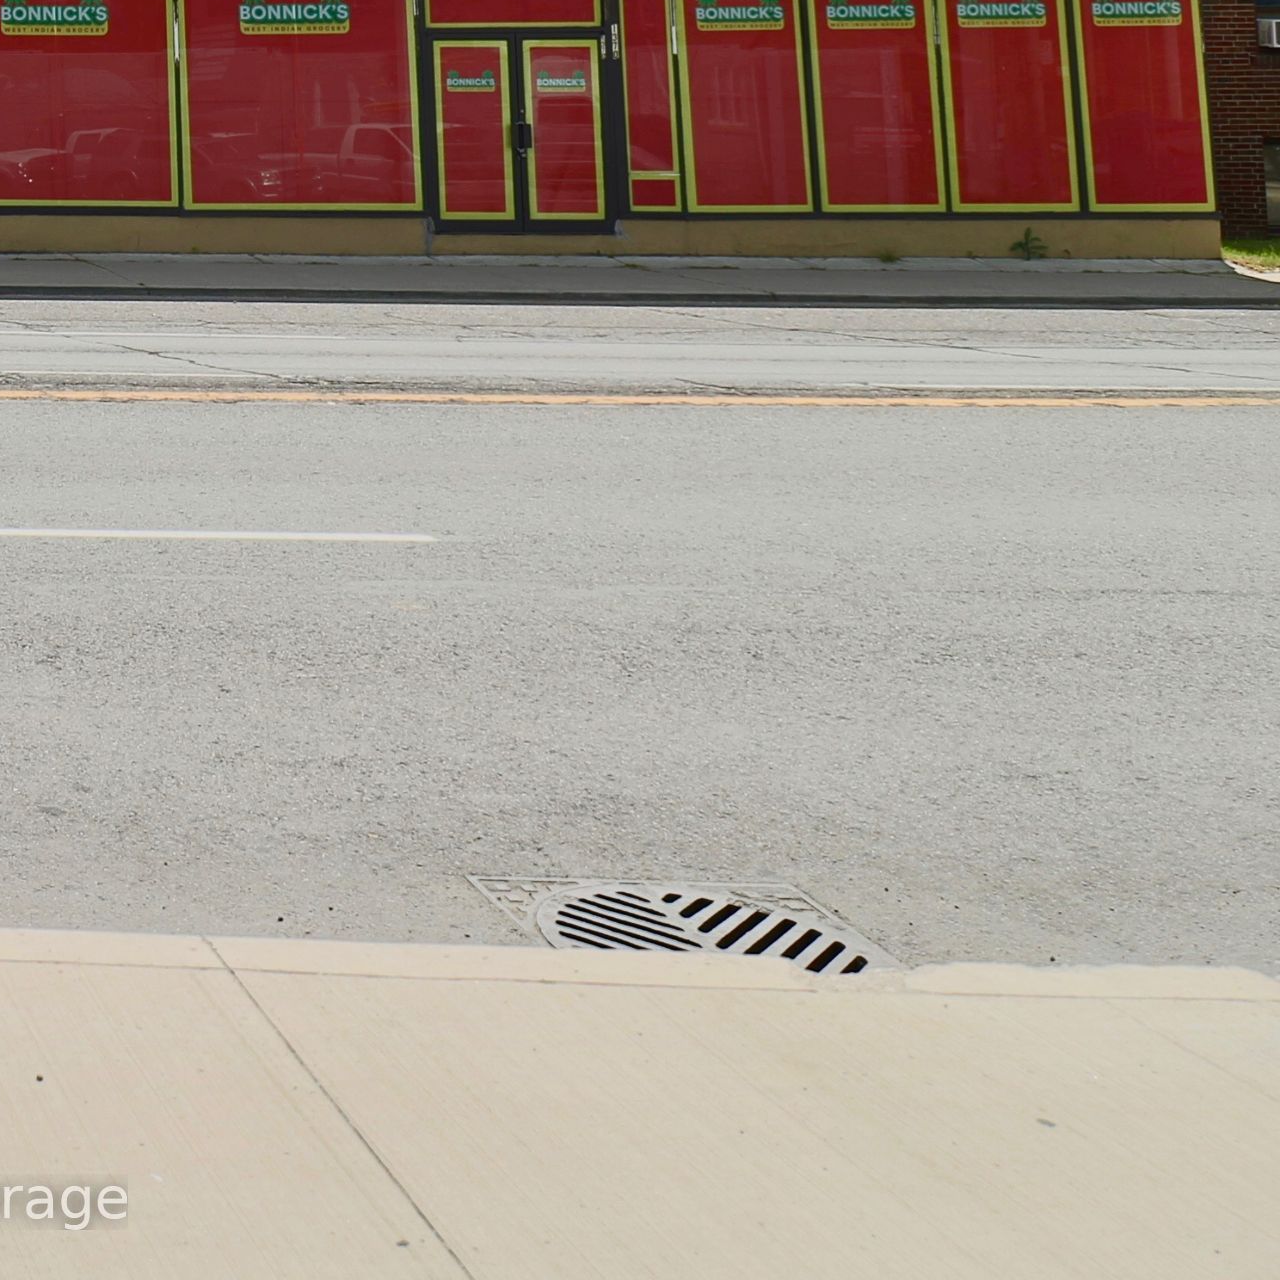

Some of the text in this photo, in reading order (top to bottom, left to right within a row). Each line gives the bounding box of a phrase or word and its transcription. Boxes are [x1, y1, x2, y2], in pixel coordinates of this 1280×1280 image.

[0, 6, 108, 21] BONNICK'S
[239, 4, 349, 20] BONNICK'S
[696, 6, 784, 20] BONNICK'S
[826, 5, 915, 18] BONNICK'S
[957, 3, 1046, 16] BONNICK'S
[1092, 2, 1182, 15] BONNICK'S
[446, 78, 496, 87] BONNICK'S
[536, 78, 586, 87] BONNICK'S
